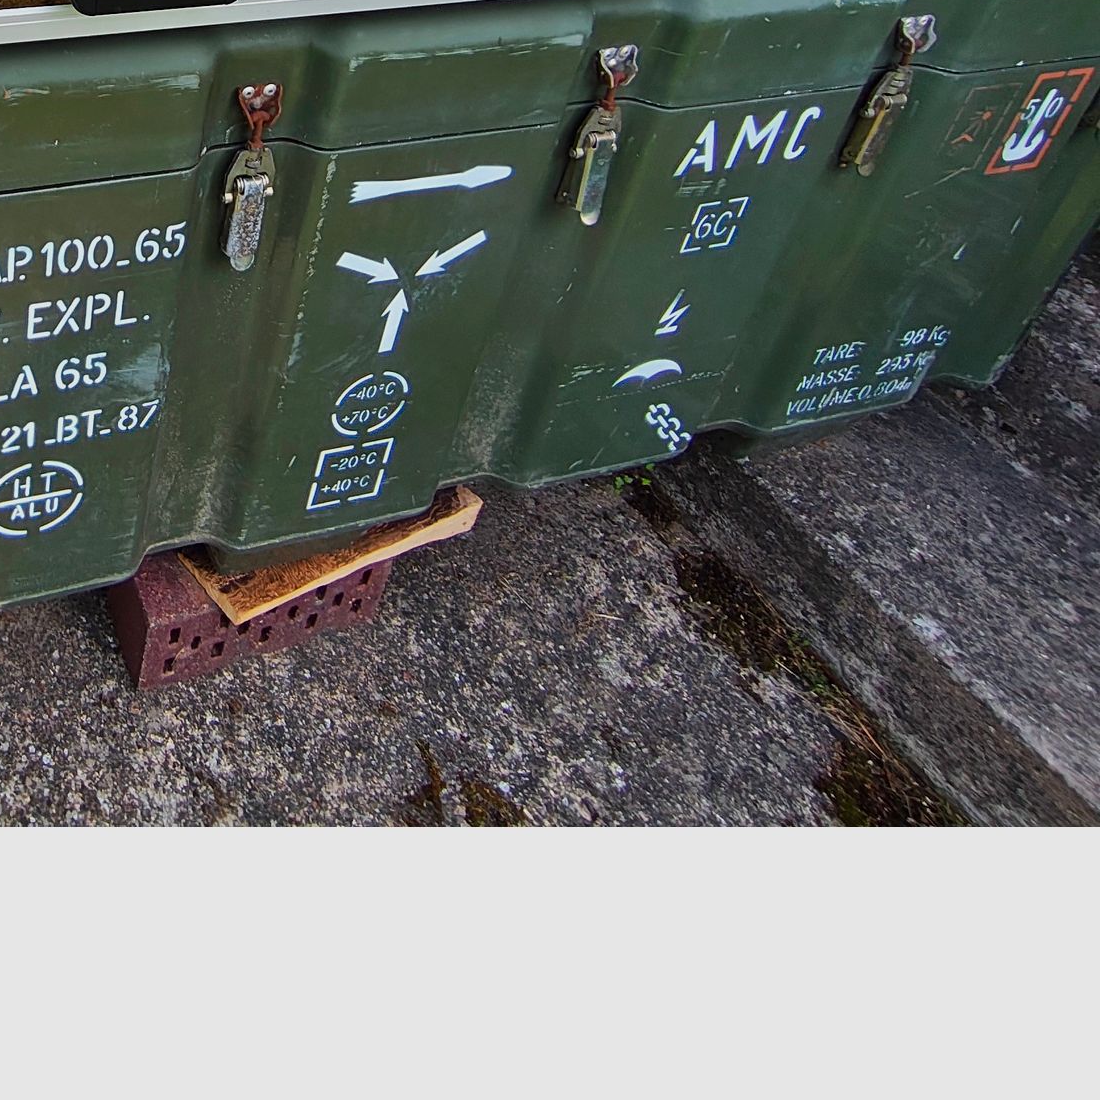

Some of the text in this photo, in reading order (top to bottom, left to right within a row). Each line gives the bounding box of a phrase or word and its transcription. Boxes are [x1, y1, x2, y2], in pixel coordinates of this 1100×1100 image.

[673, 106, 821, 177] AMC
[694, 210, 733, 239] 6C
[27, 290, 150, 340] EXPL.
[55, 353, 107, 390] 65
[11, 496, 59, 521] ALU
